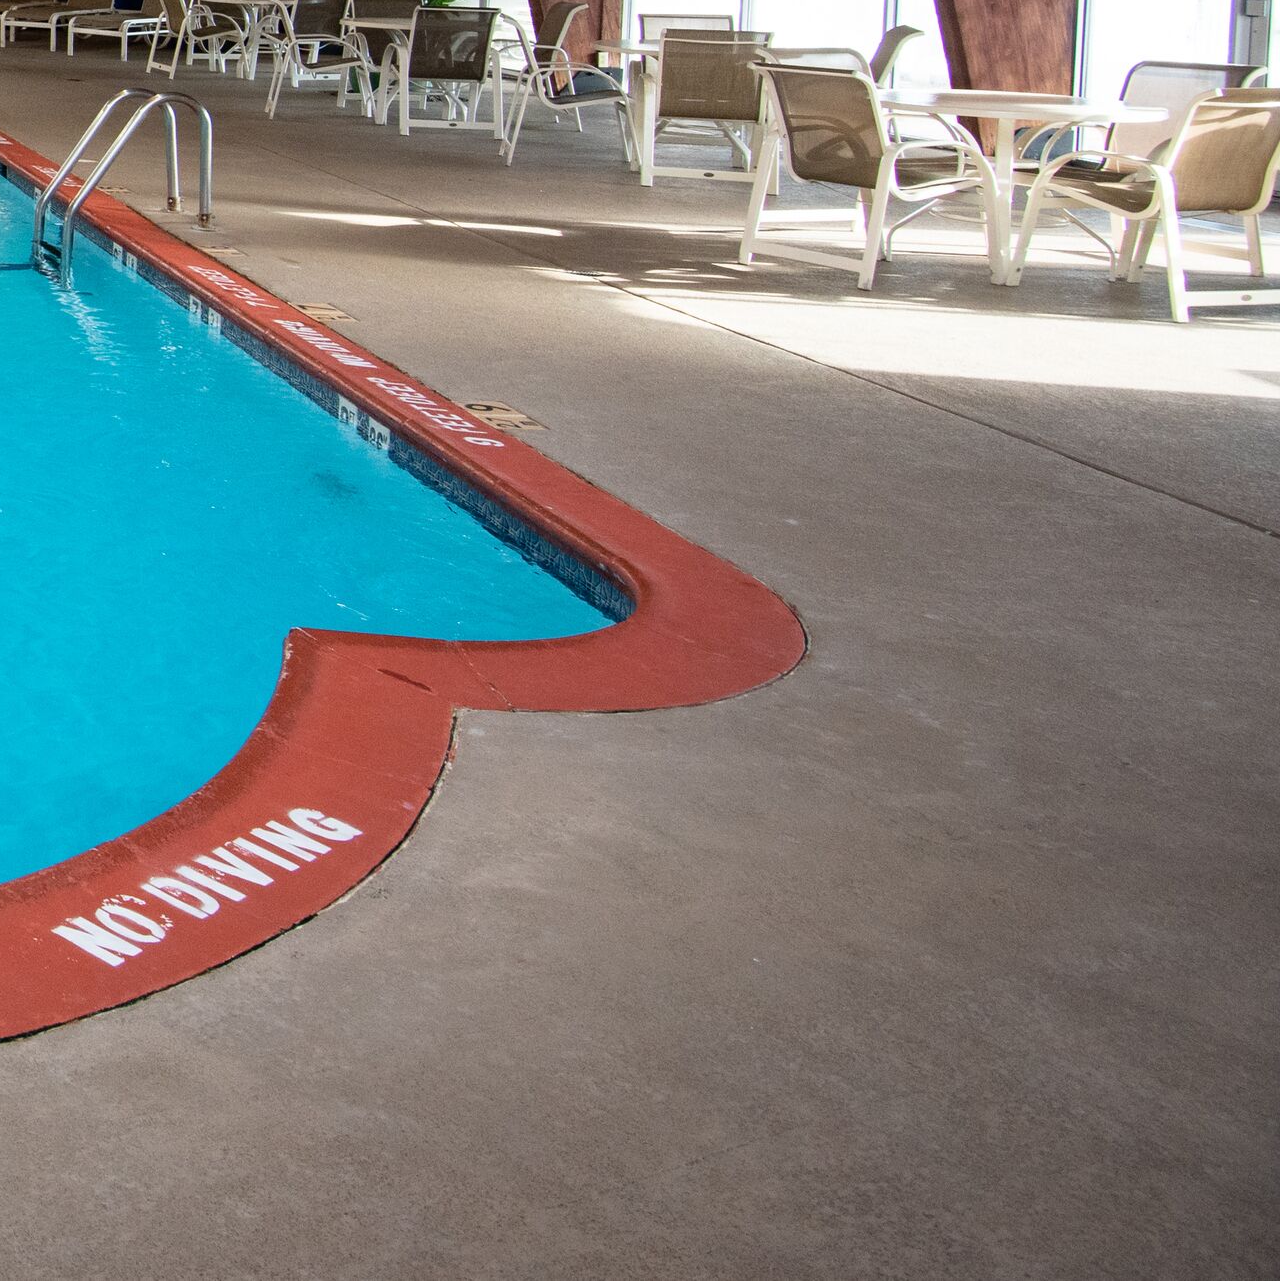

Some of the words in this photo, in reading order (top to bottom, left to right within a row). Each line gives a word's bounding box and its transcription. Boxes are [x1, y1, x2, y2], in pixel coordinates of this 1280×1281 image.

[245, 300, 279, 309] 7
[272, 319, 351, 353] DIVING
[329, 352, 378, 369] NO
[367, 377, 437, 406] DEEP
[409, 403, 488, 434] FEET
[463, 436, 505, 447] 9
[51, 895, 168, 967] NO
[141, 807, 363, 920] DIVING
